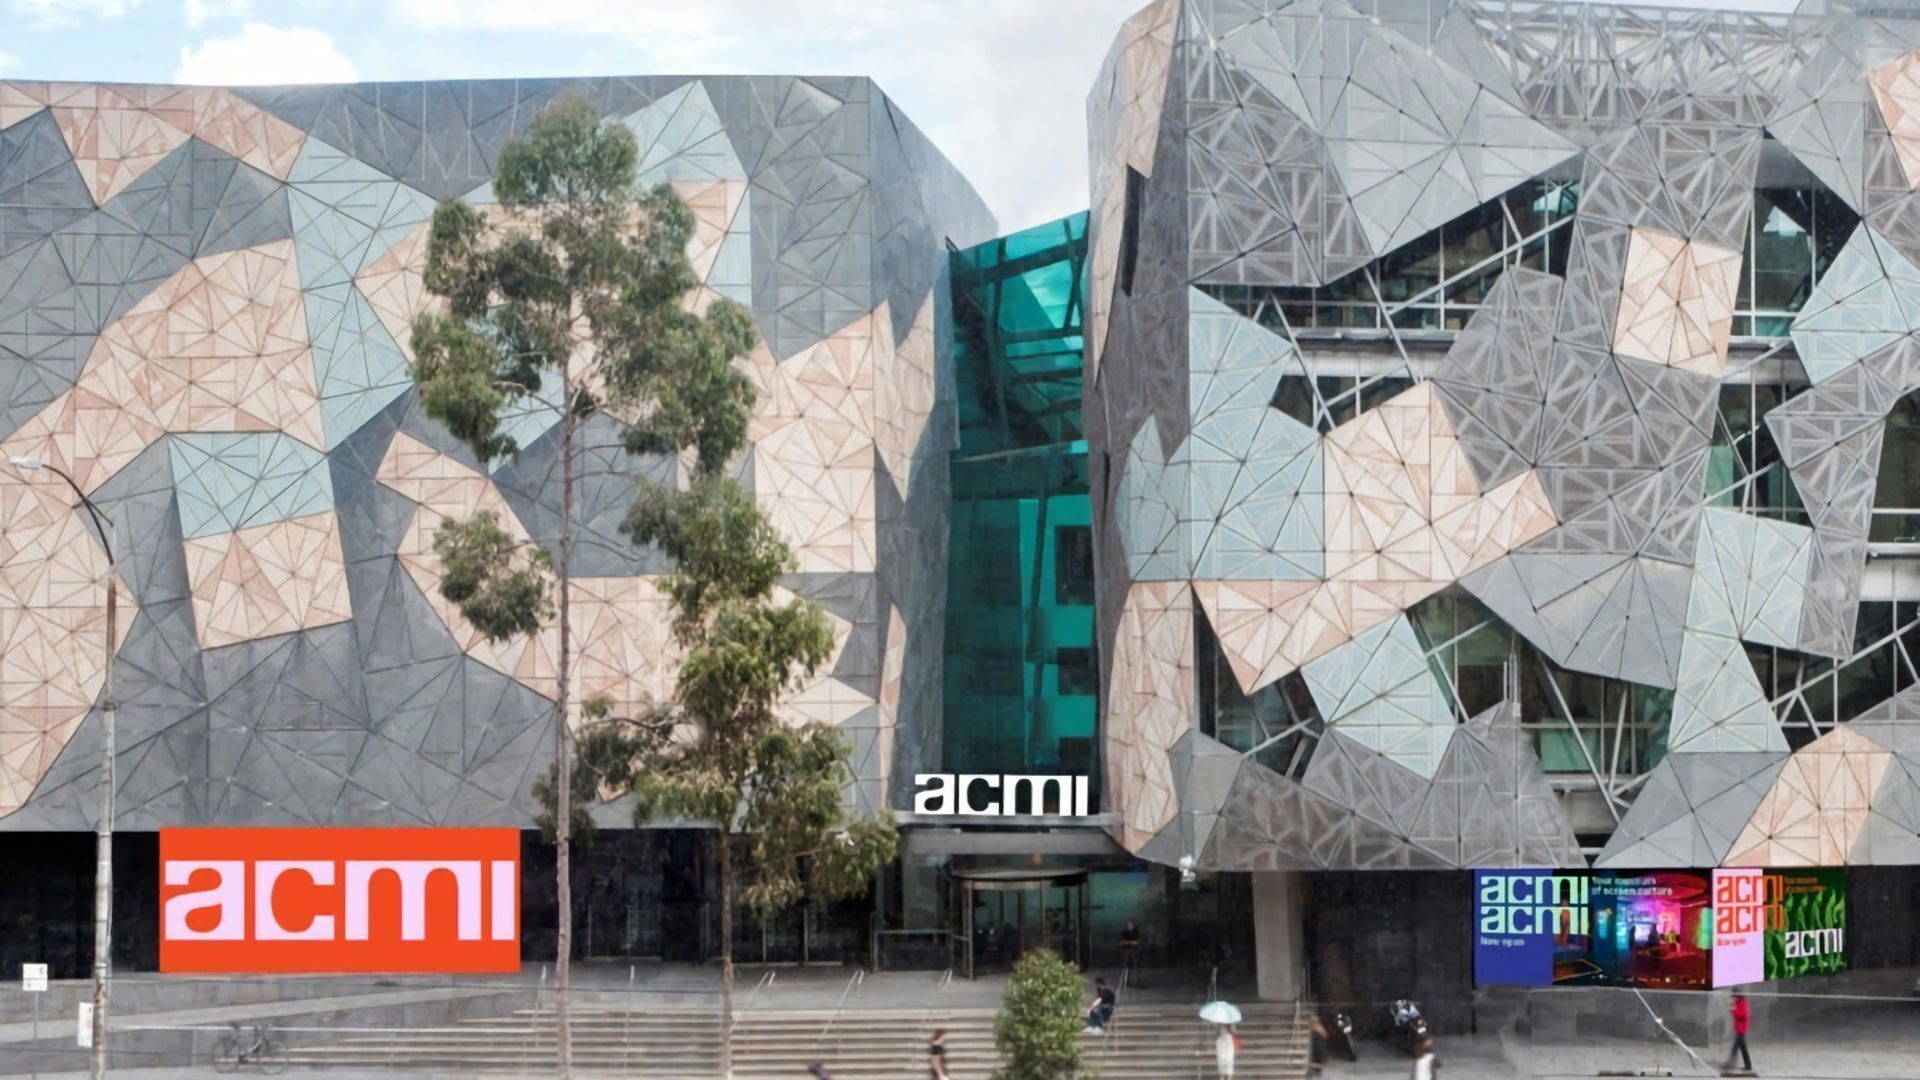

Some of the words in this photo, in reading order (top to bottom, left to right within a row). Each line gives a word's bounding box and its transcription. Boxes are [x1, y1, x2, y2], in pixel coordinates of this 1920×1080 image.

[916, 775, 1087, 815] acmi
[165, 861, 514, 940] acmi
[1481, 876, 1588, 904] acmi
[1717, 875, 1783, 904] acmi
[1481, 906, 1588, 935] acmi
[1717, 905, 1784, 934] acmi
[1785, 928, 1842, 958] acmi
